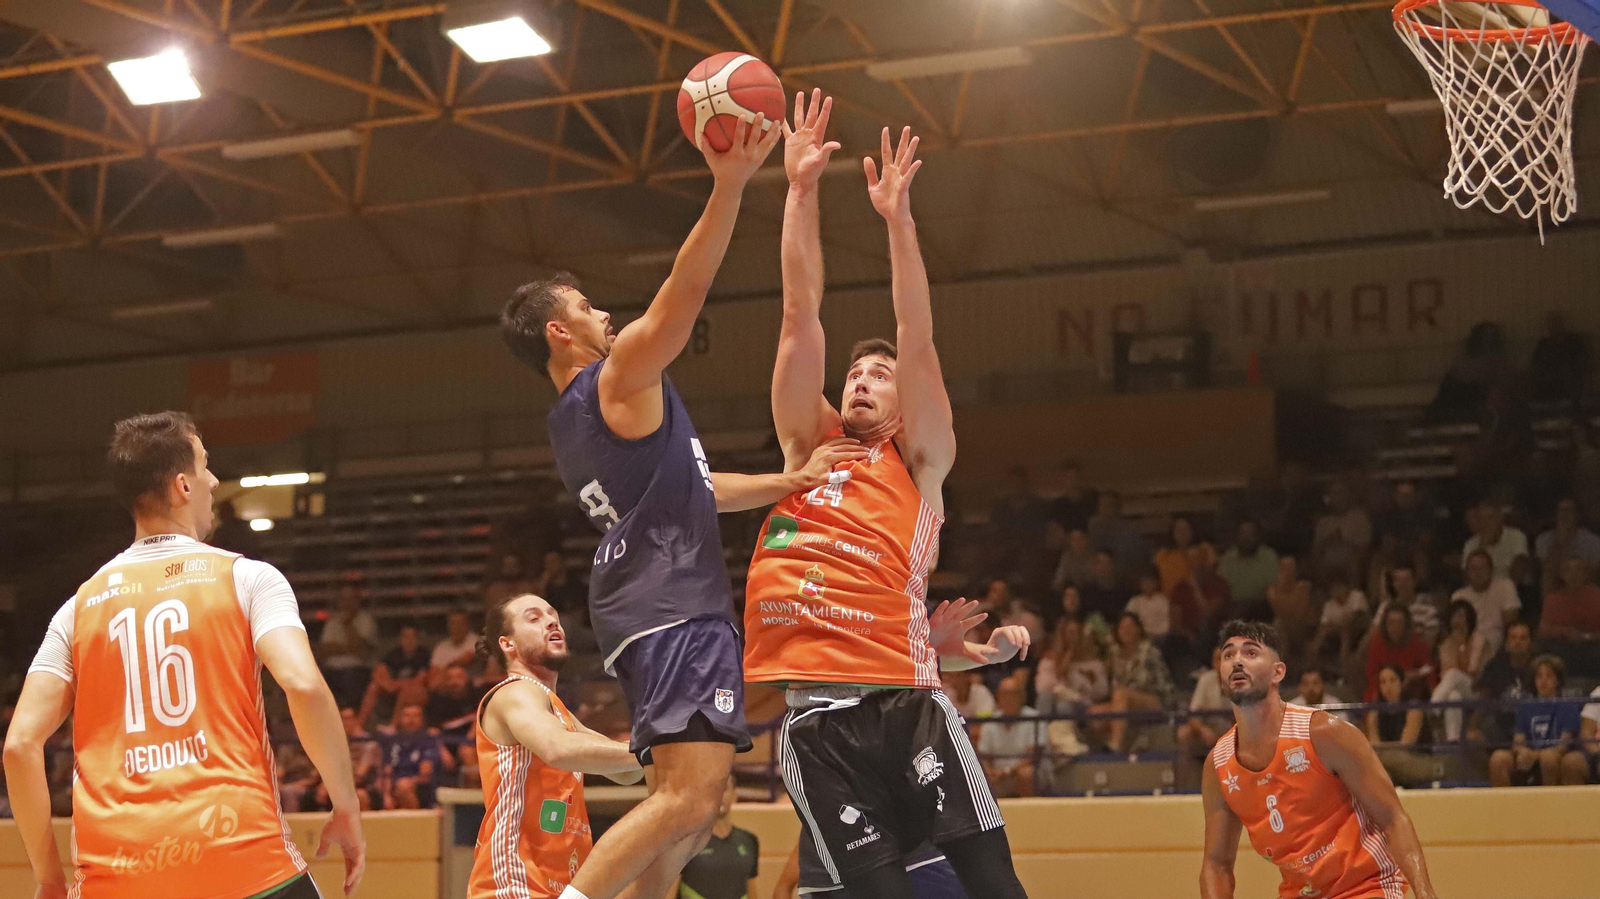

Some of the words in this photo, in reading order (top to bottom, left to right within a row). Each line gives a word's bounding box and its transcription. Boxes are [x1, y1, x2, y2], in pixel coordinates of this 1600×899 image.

[143, 536, 159, 546] NIKE
[159, 534, 177, 543] PRO
[86, 582, 142, 607] maxoil
[760, 601, 875, 622] AYUNTAMIENTO
[108, 598, 197, 733] 16
[1266, 794, 1284, 833] 6
[846, 831, 881, 851] RETAMARES
